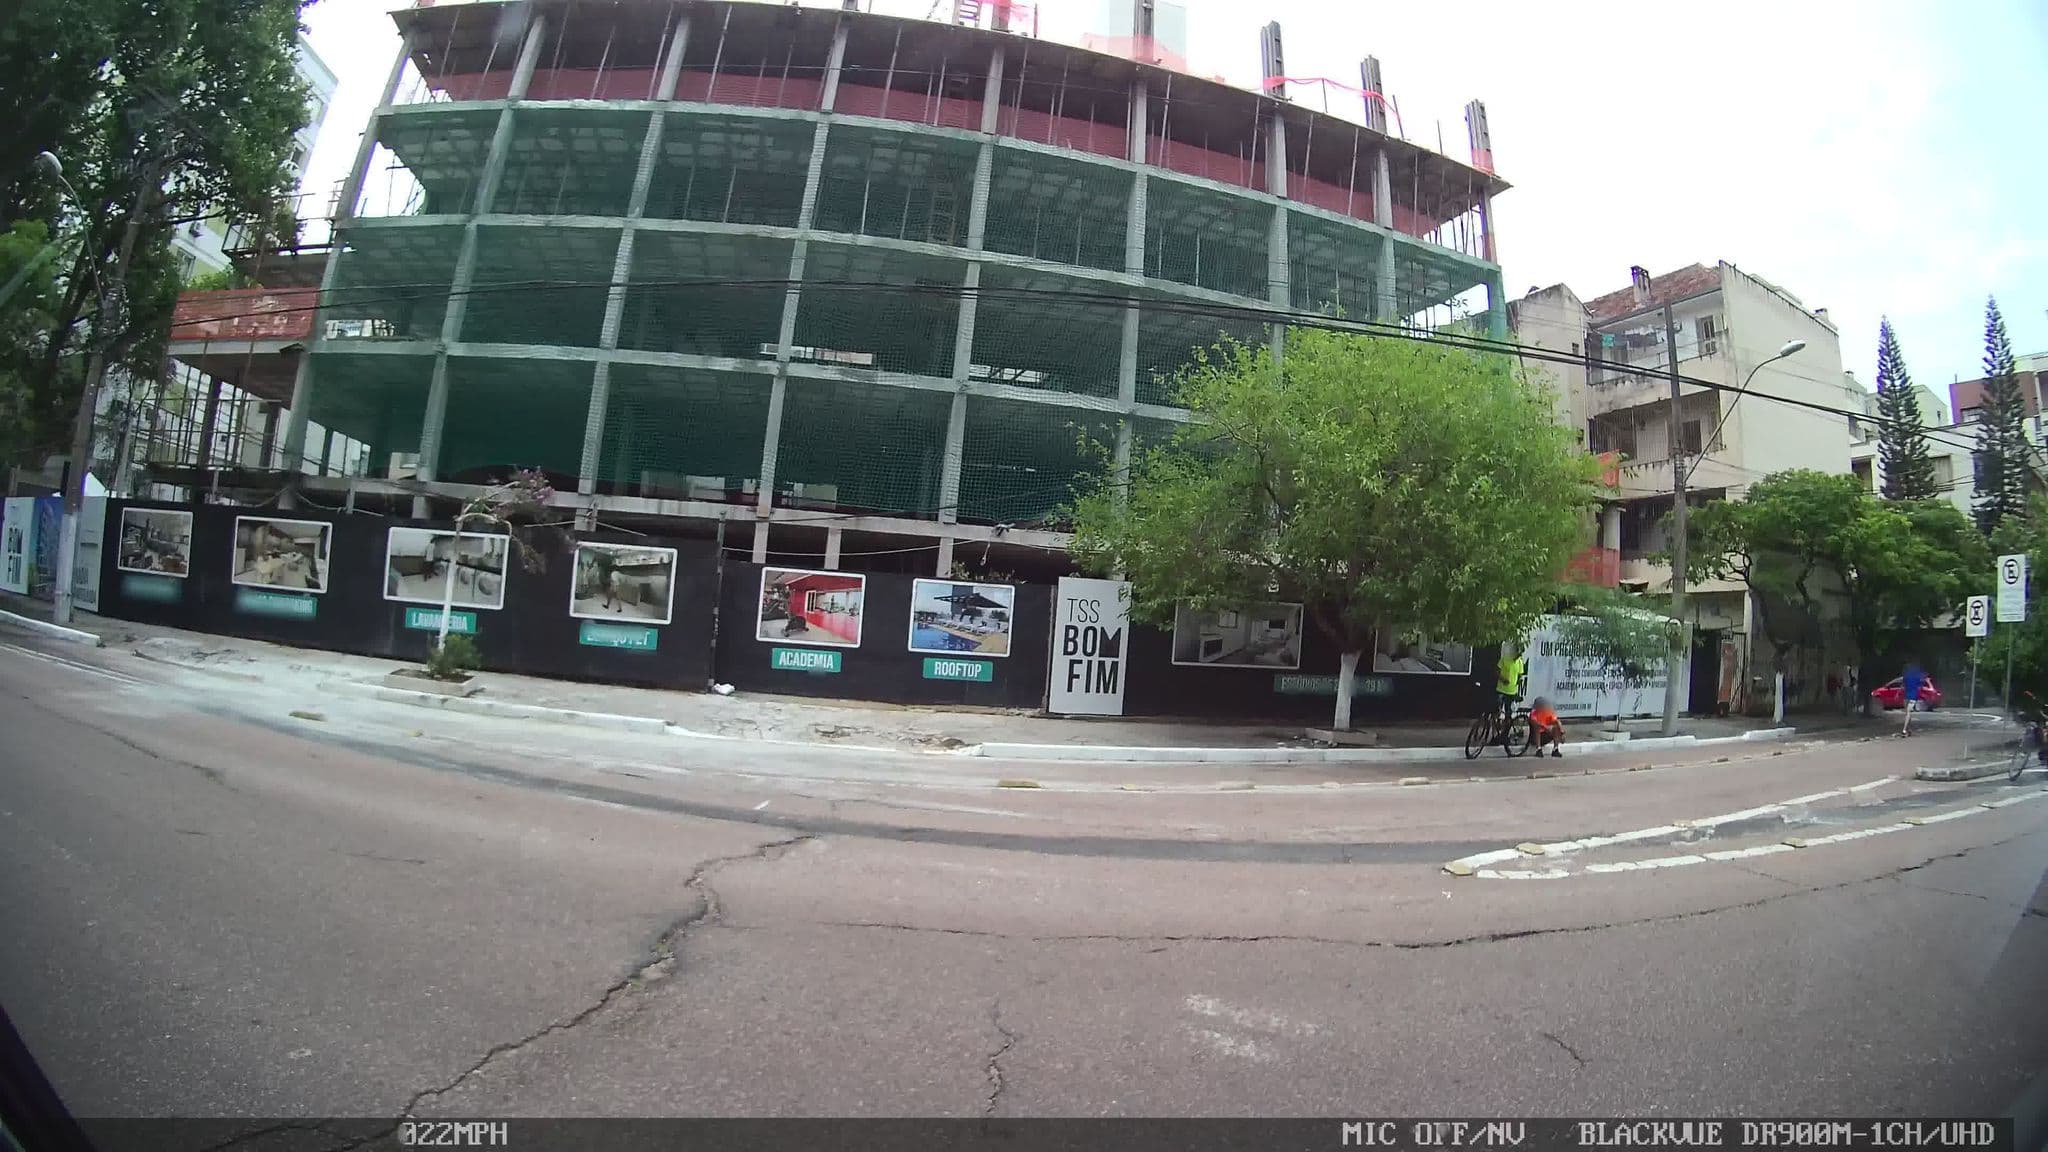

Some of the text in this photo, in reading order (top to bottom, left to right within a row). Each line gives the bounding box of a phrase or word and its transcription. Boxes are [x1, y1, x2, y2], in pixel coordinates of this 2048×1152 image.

[1066, 598, 1100, 624] TSS
[1063, 625, 1122, 658] BOM
[778, 653, 835, 670] ACADEMIA
[933, 661, 982, 678] ROOFTOP
[1066, 659, 1119, 694] FIM
